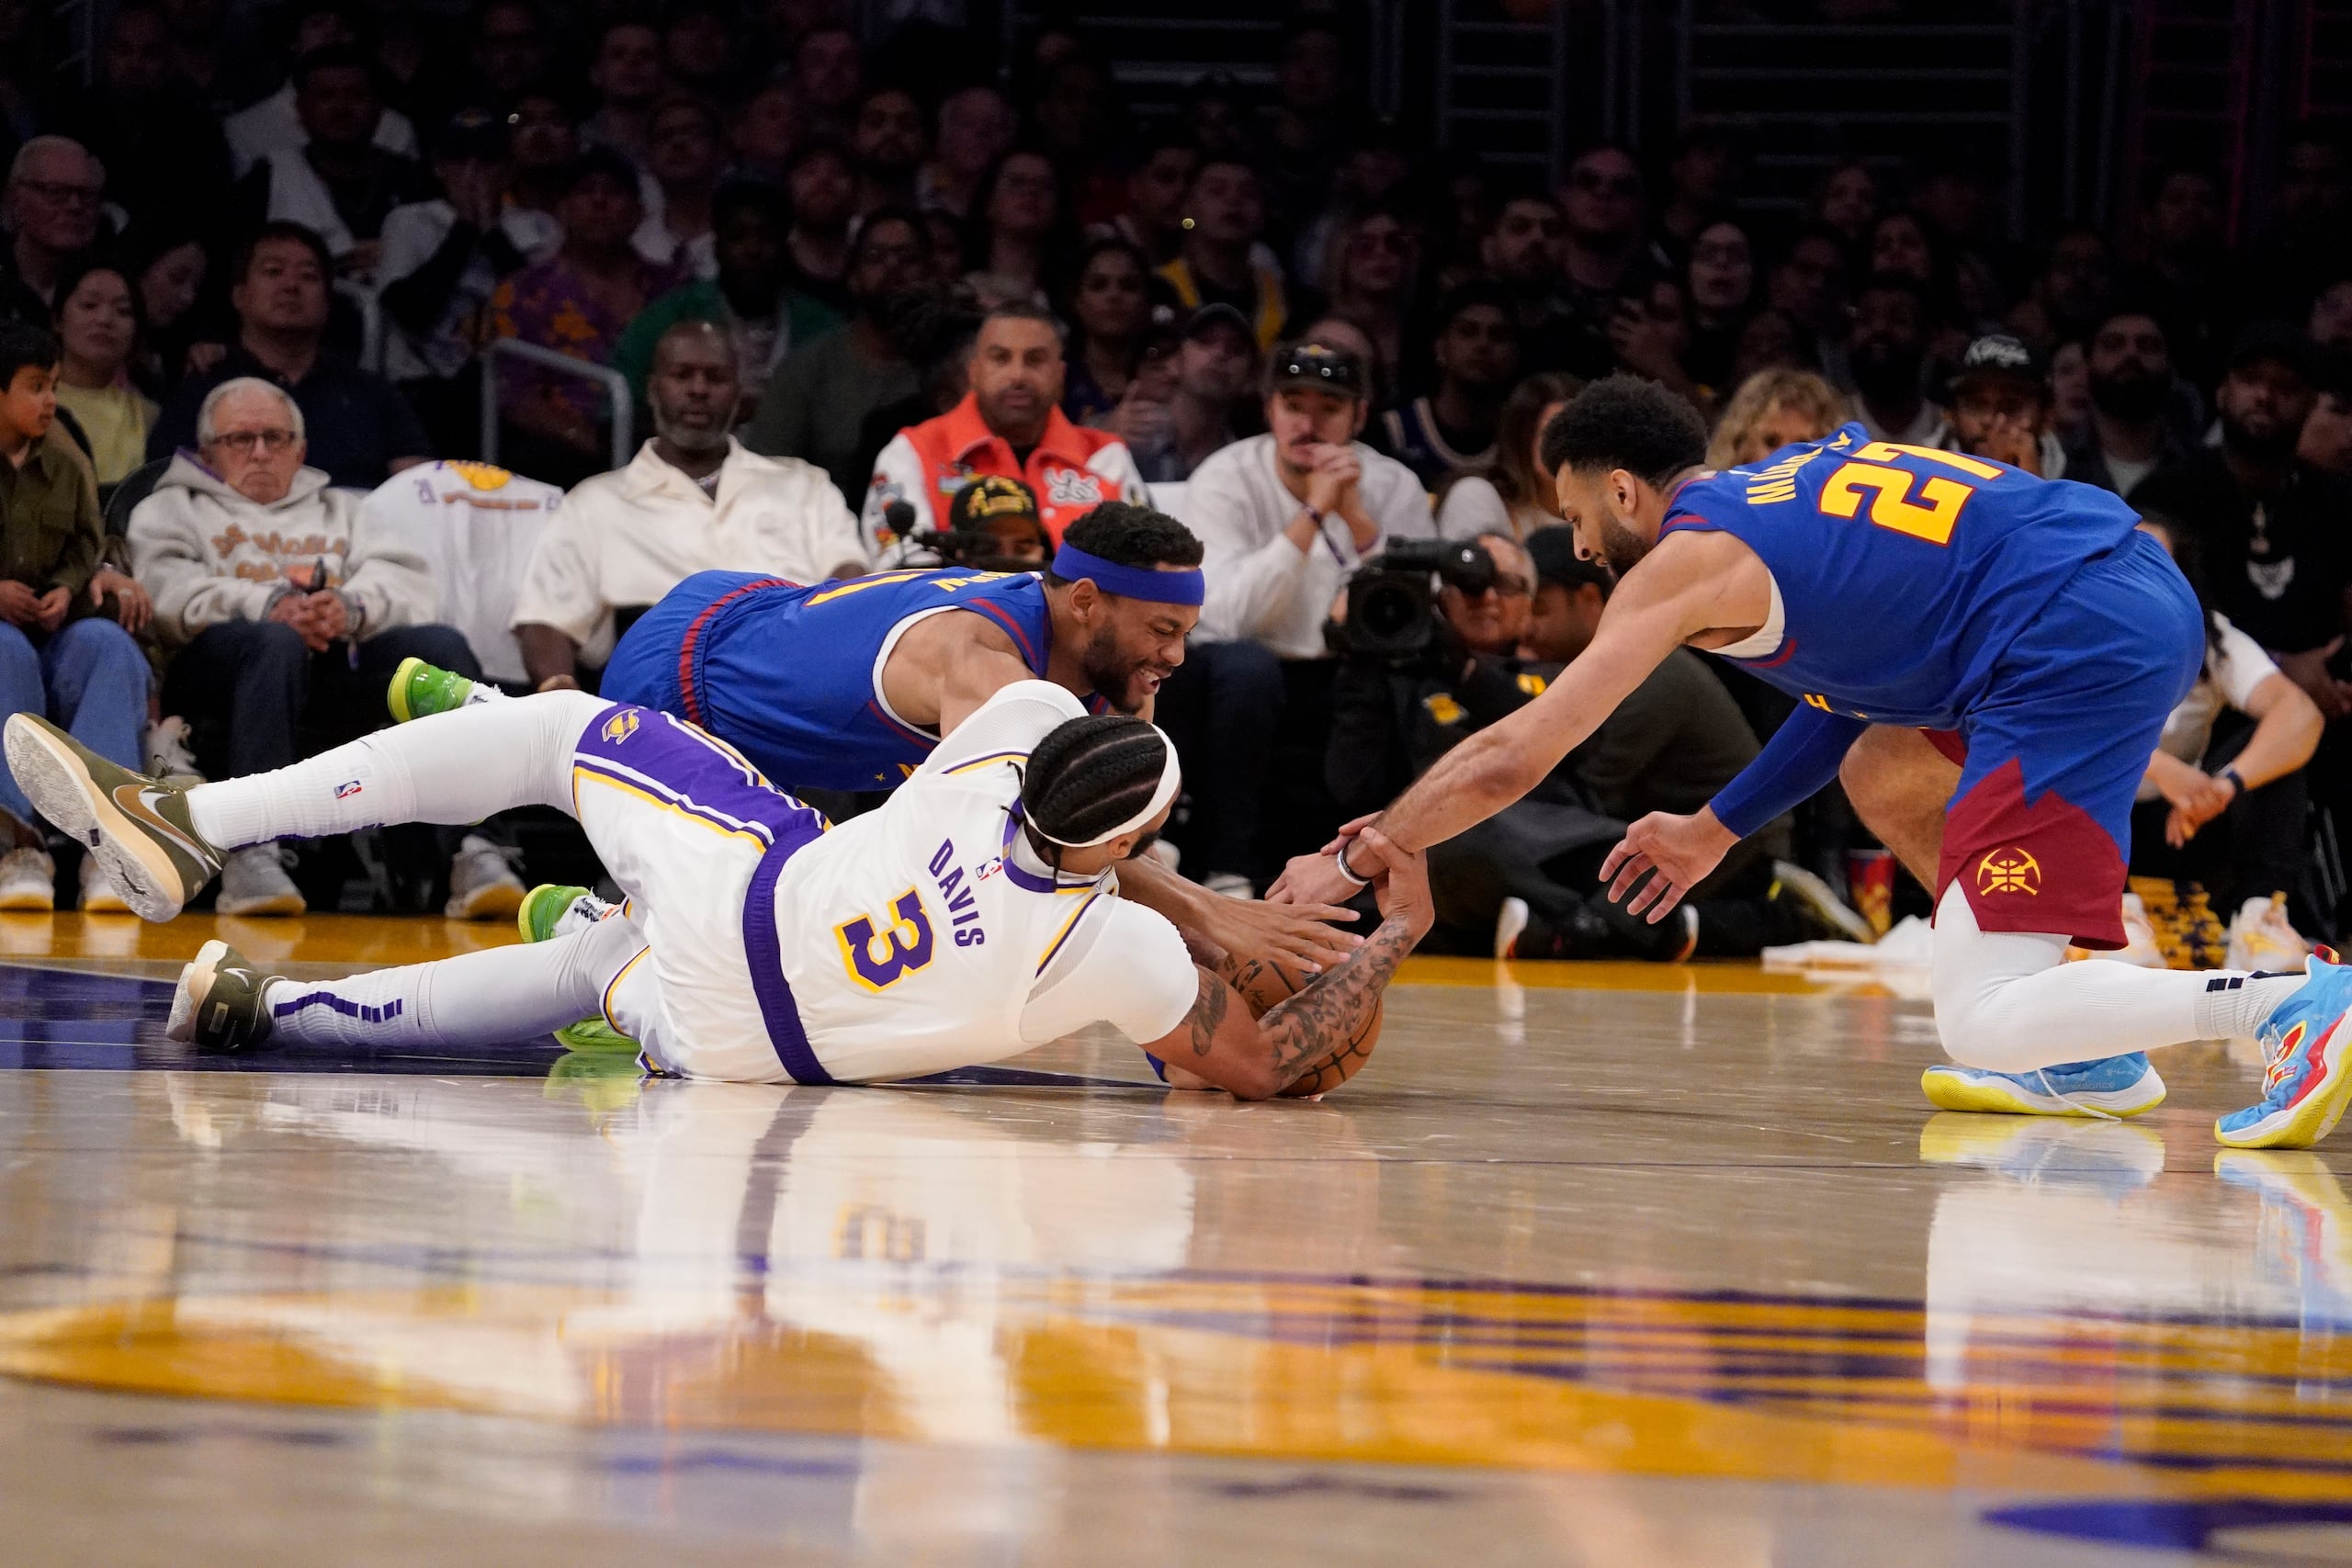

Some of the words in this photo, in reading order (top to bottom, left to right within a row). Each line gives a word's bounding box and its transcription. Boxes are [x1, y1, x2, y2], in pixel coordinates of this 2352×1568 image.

[1817, 441, 2007, 547] 27
[833, 886, 935, 992] 3
[928, 838, 985, 947] DAVIS
